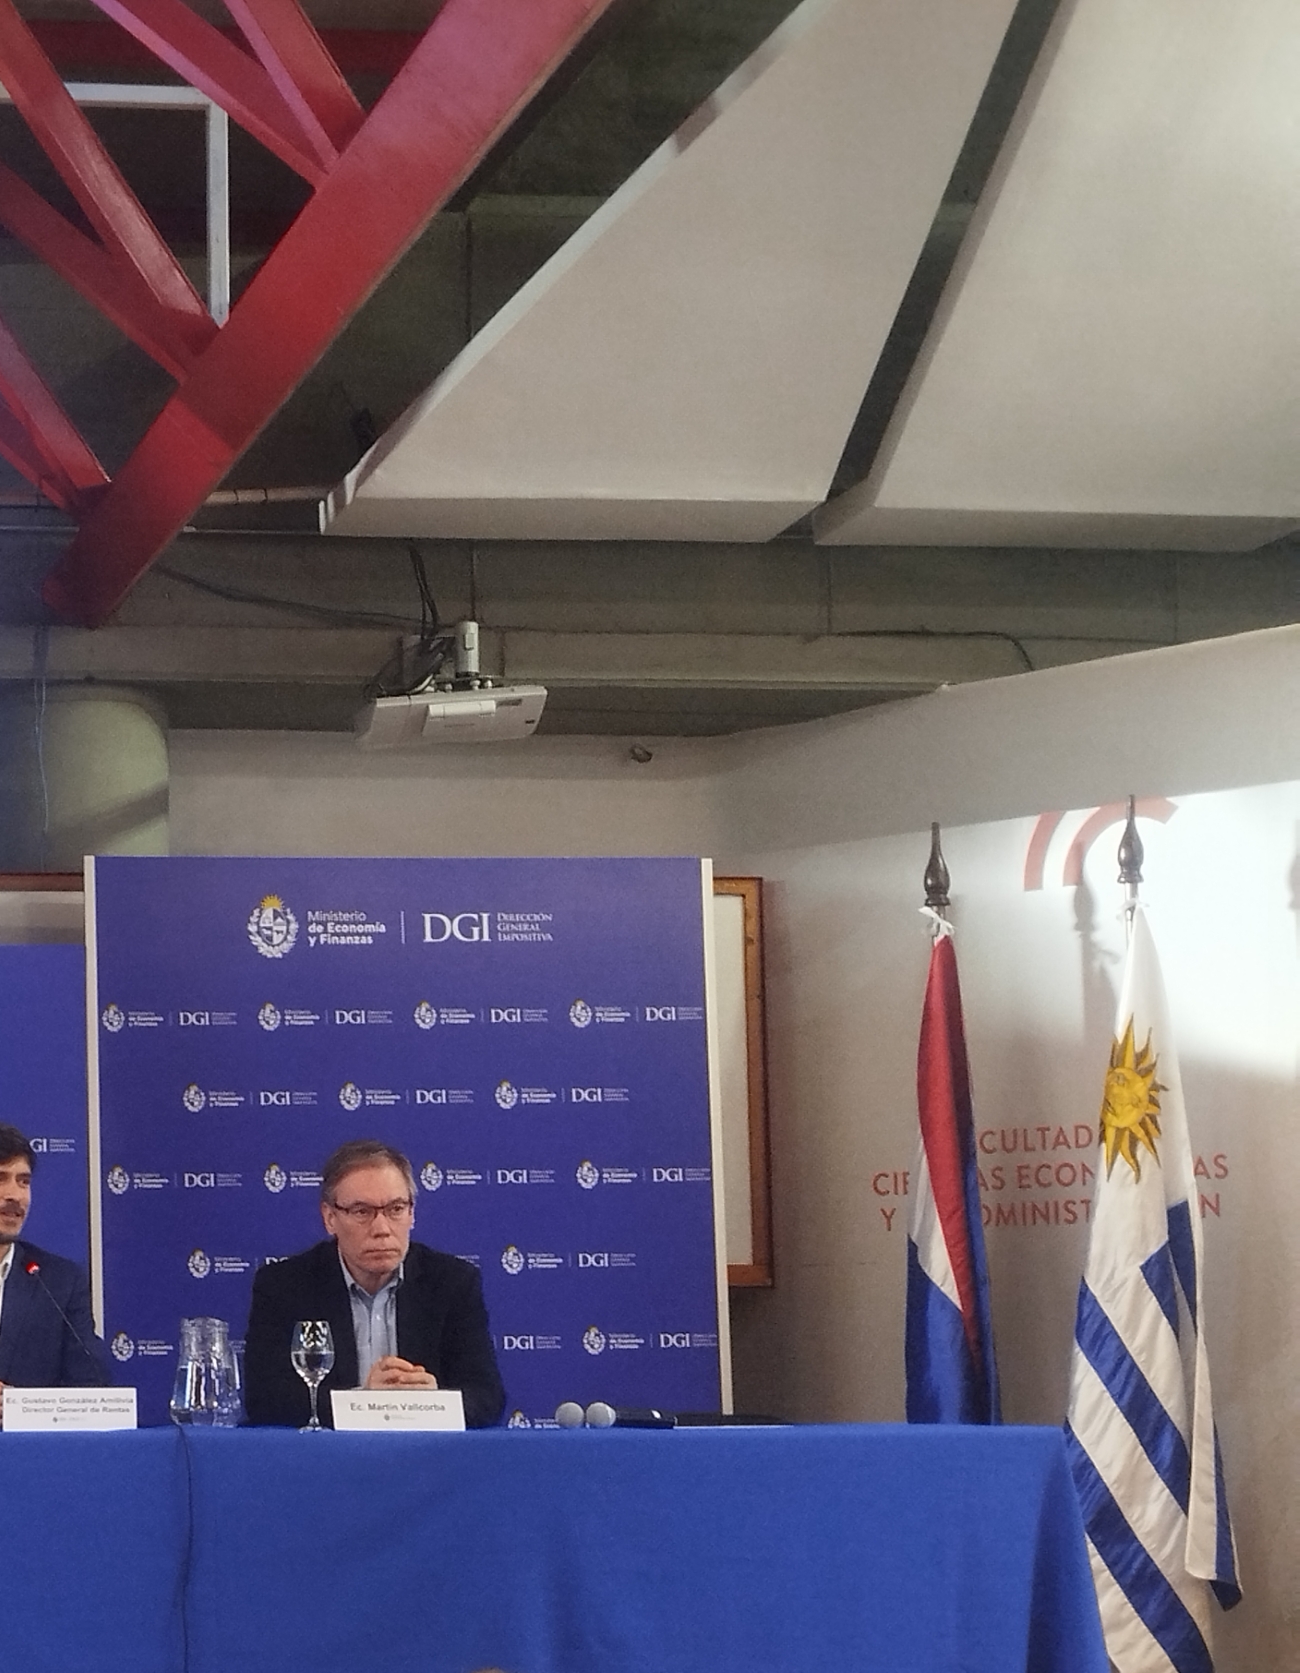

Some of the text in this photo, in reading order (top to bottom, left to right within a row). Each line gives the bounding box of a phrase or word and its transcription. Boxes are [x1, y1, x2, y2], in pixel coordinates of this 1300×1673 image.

[307, 911, 367, 921] Ministerio
[308, 921, 386, 933] de Economía
[422, 912, 492, 943] DGI
[308, 934, 373, 947] y Finanzas
[180, 1012, 209, 1025] DGI
[336, 1010, 365, 1024] DGI
[491, 1009, 521, 1022] DGI
[646, 1007, 676, 1021] DGI
[260, 1092, 290, 1105] DGI
[416, 1090, 446, 1103] DGI
[572, 1088, 601, 1102] DGI
[979, 1125, 1094, 1154] CULTAD
[185, 1173, 214, 1187] DGI
[497, 1170, 527, 1184] DGI
[653, 1168, 683, 1182] DGI
[880, 1207, 896, 1232] Y
[579, 1253, 608, 1267] DGI
[504, 1336, 534, 1349] DGI
[660, 1334, 690, 1347] DGI
[350, 1403, 364, 1411] Ec.
